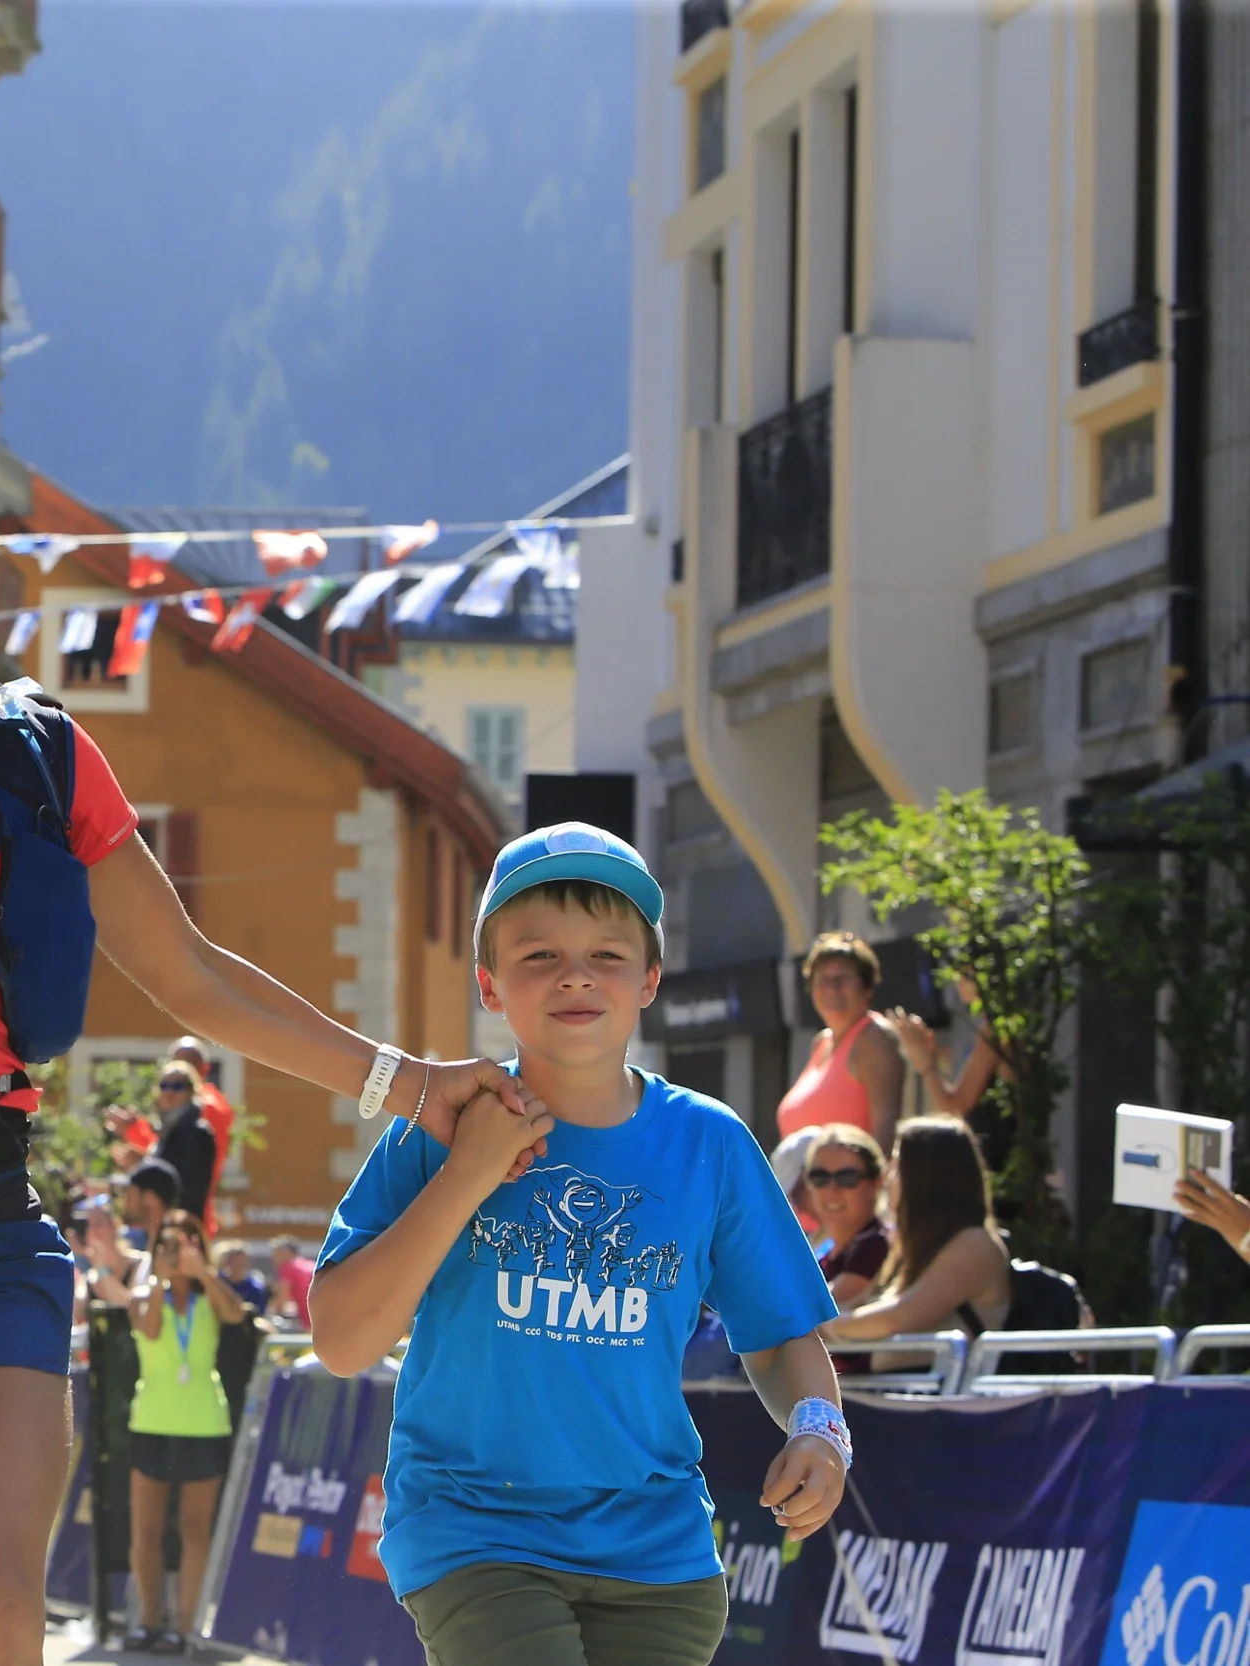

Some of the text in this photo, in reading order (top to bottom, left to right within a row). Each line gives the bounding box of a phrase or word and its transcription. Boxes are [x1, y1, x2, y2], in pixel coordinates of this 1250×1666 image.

[497, 1270, 648, 1333] UTMB
[497, 1320, 645, 1347] UTMB CCC TDS PTL OCC MCC YCC
[955, 1543, 1086, 1666] CAMELBAK
[1164, 1575, 1250, 1666] Col
